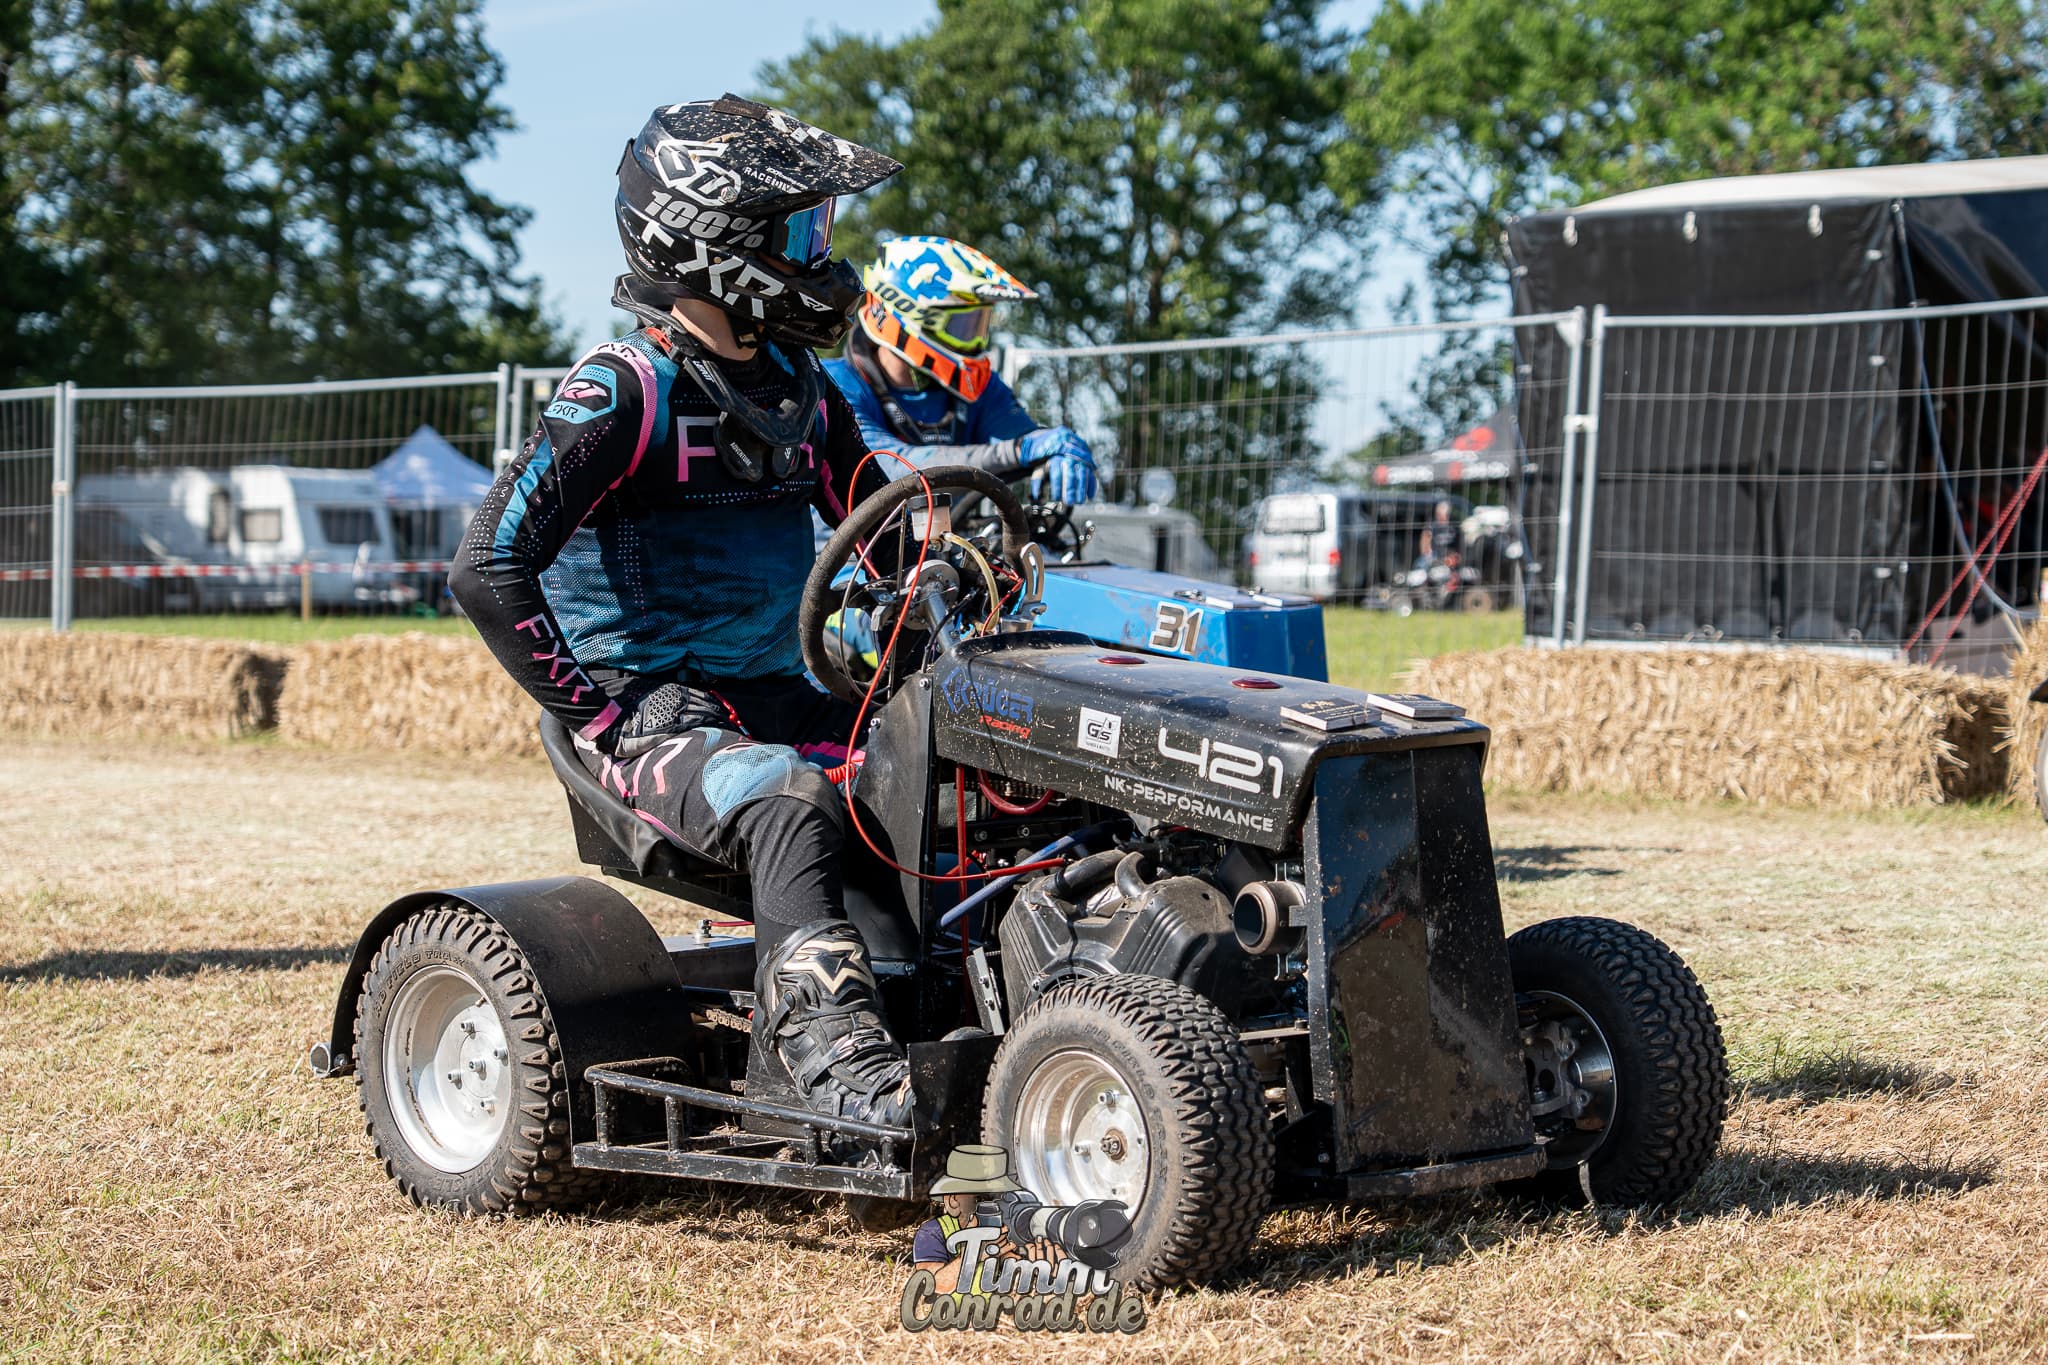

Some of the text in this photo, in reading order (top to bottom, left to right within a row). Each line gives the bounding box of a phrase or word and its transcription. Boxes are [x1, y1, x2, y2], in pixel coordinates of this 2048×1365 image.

[644, 190, 768, 248] 100%
[874, 282, 942, 327] 100%
[1149, 600, 1204, 655] 31
[514, 612, 595, 704] FXR
[979, 714, 1032, 740] Racing
[1158, 727, 1284, 799] 421
[1104, 774, 1274, 833] NK-PERFORMANCE
